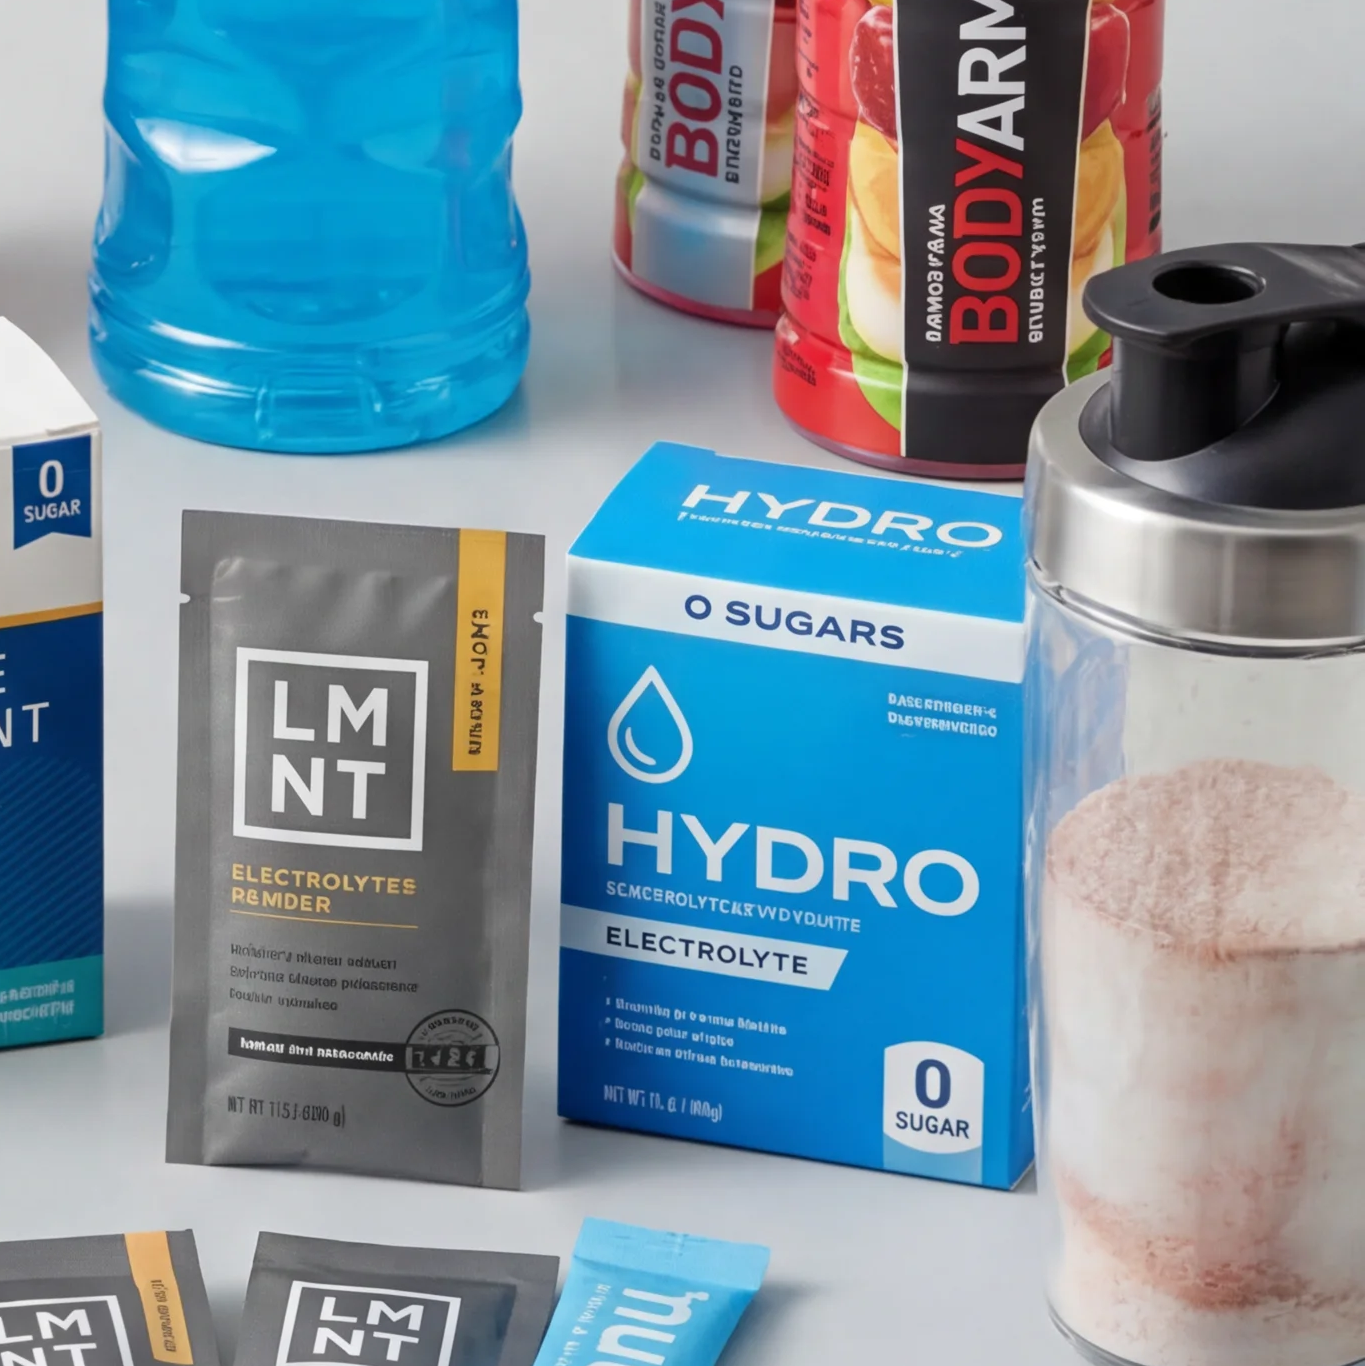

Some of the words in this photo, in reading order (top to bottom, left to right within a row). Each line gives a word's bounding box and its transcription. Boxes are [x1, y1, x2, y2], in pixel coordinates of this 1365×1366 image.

[37, 460, 64, 498] 0
[22, 498, 83, 524] SUGAR
[681, 484, 1004, 549] HYDRO
[725, 599, 906, 651] SUGARS
[231, 863, 418, 896] ELECTROLYTES
[607, 801, 981, 918] HYDRO
[605, 925, 809, 976] ELECTROLYTE
[913, 1058, 952, 1110] 0
[894, 1110, 971, 1141] SUGAR
